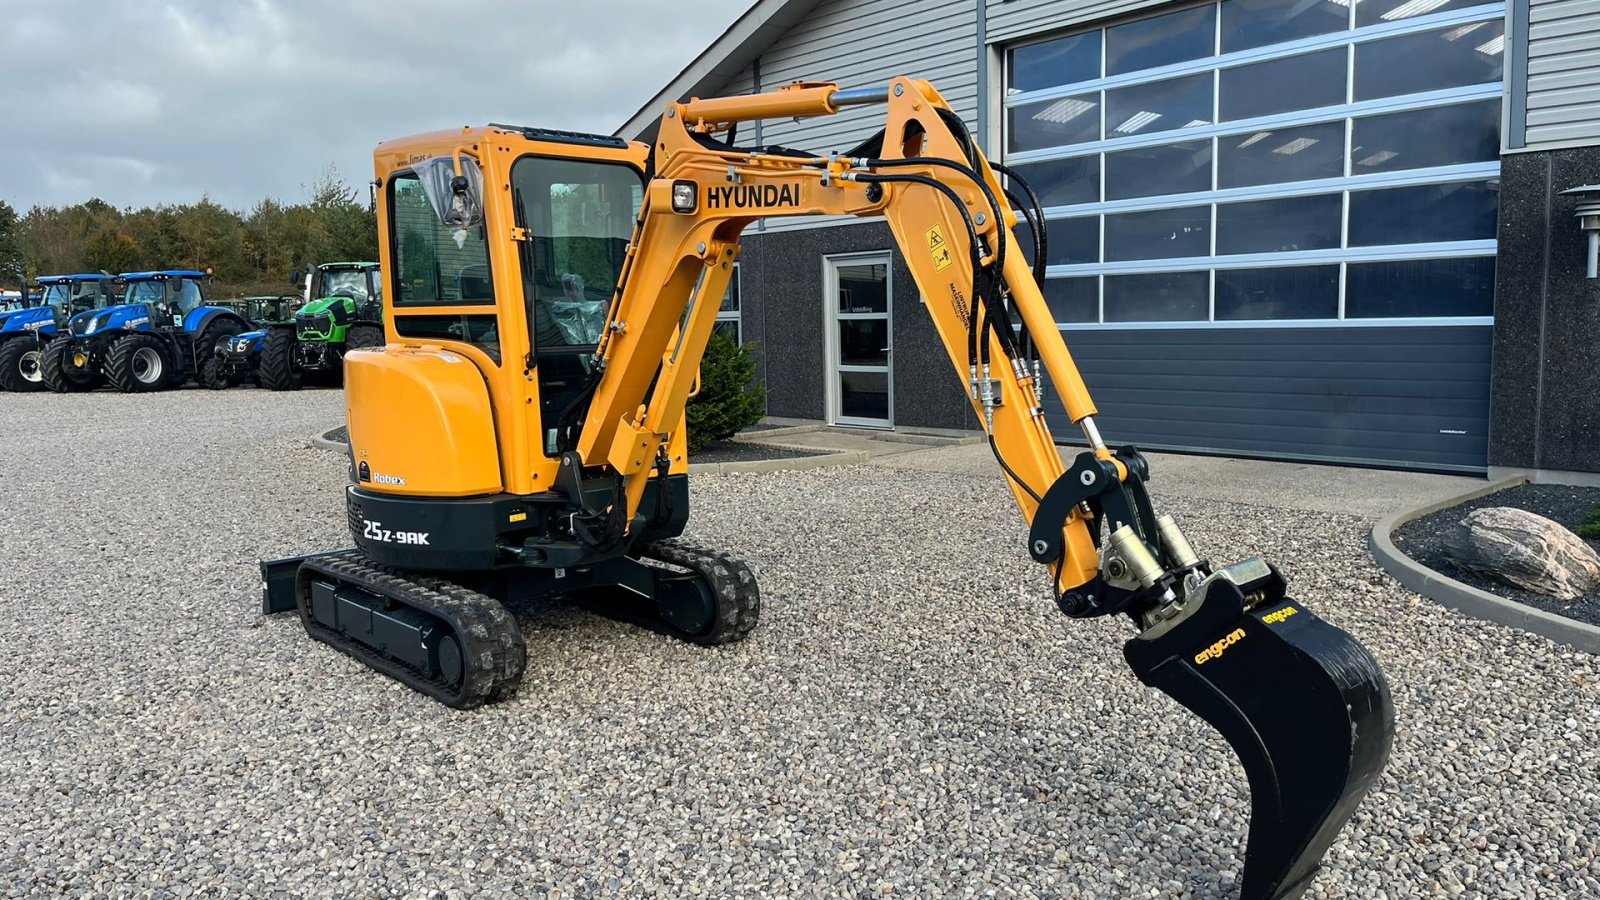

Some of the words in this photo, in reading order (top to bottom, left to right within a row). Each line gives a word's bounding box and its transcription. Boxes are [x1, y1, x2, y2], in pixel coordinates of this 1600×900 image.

[707, 183, 800, 209] HYUNDAI
[373, 472, 407, 486] Robex
[1261, 606, 1299, 624] engcon
[1194, 627, 1247, 665] engcon
